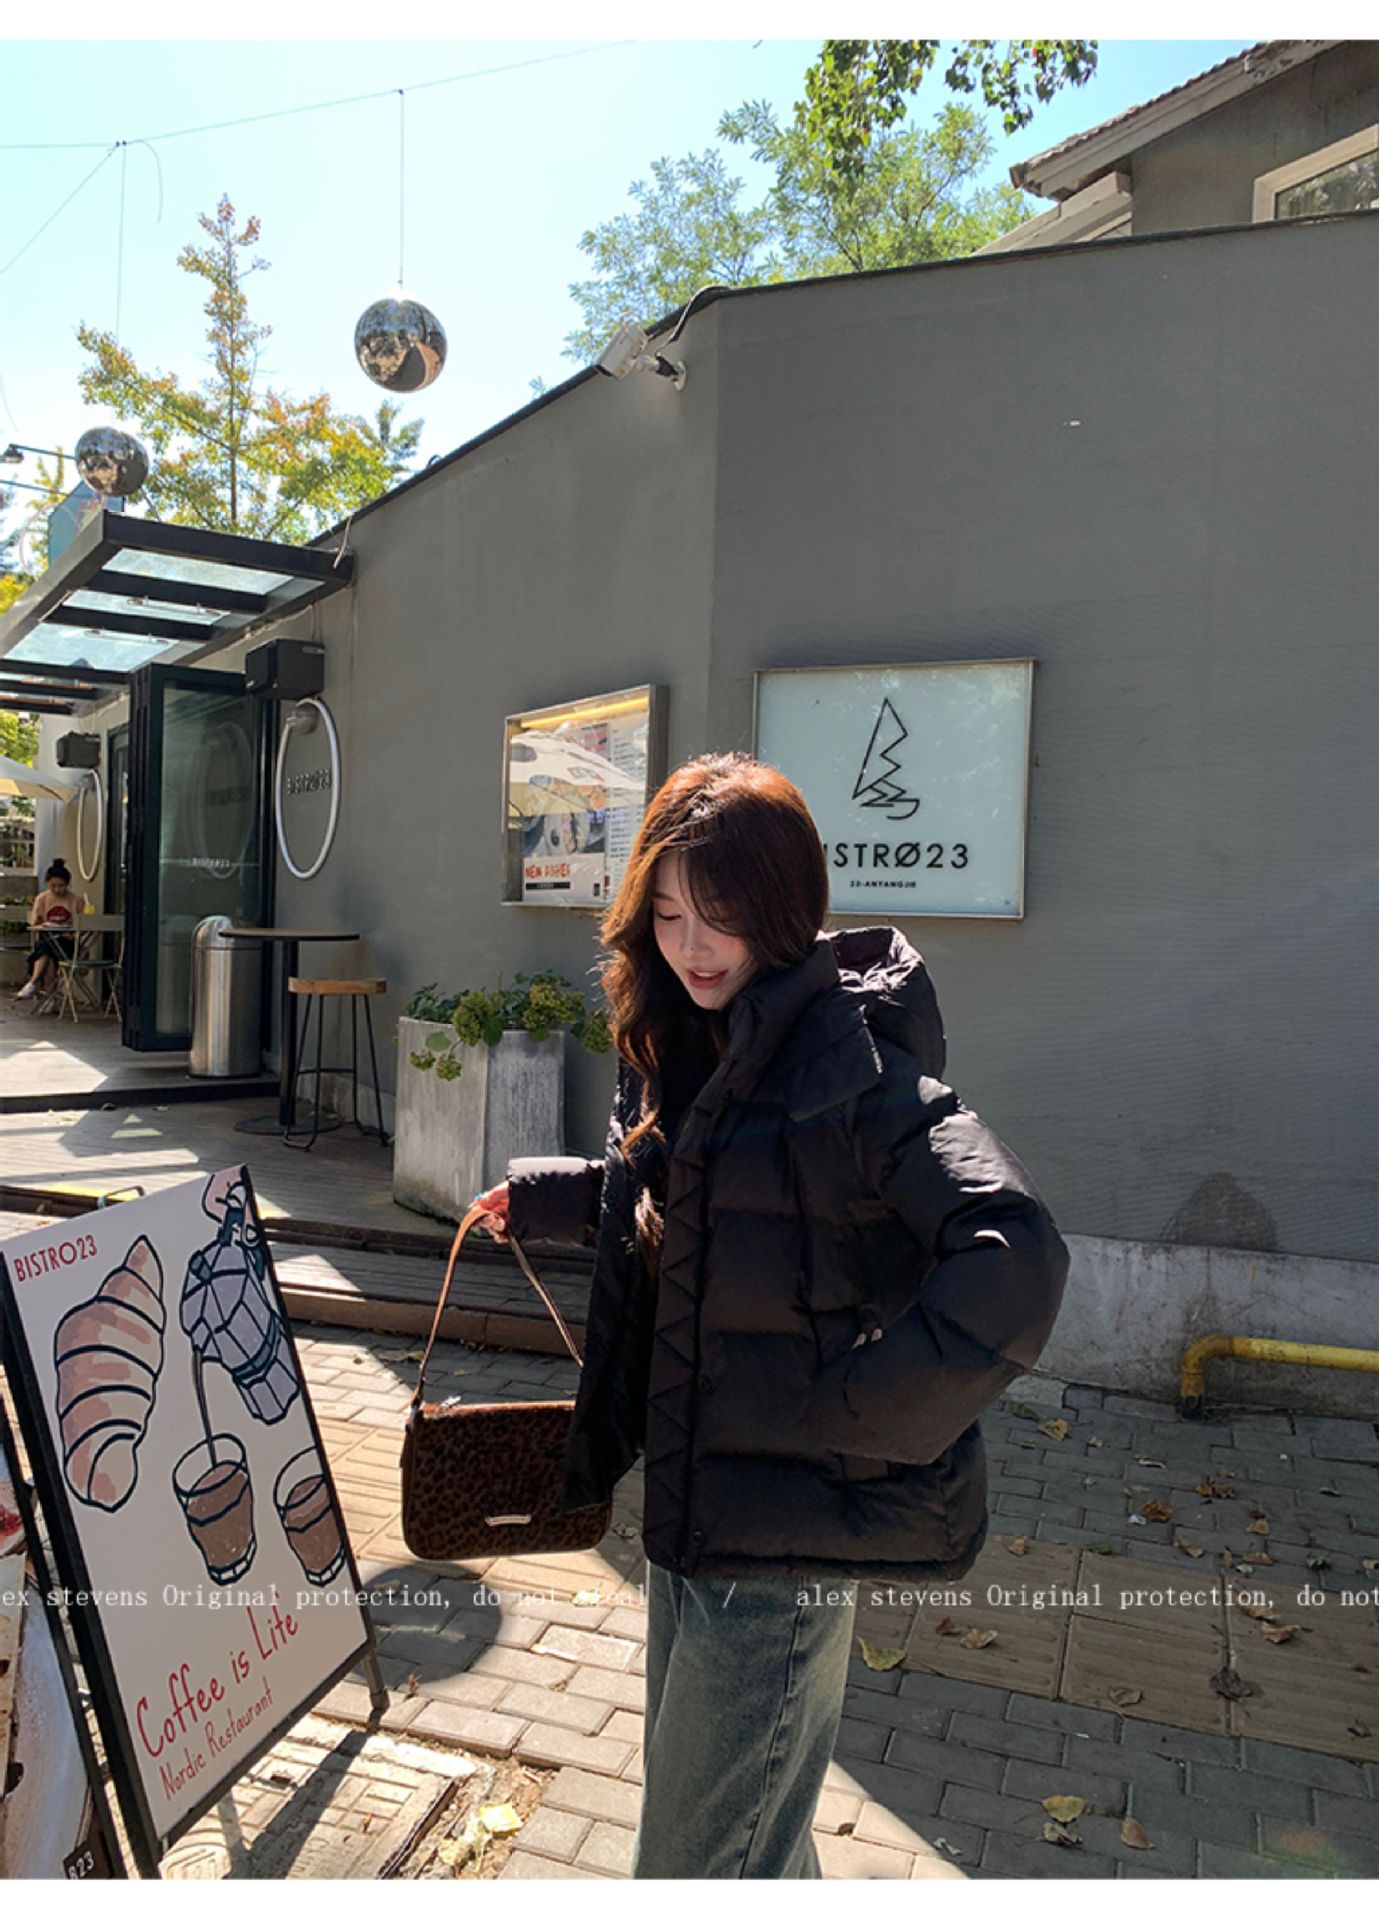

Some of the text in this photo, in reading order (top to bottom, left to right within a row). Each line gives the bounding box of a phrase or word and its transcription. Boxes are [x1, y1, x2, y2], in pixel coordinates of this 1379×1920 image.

[823, 842, 968, 869] STRØ23
[14, 1234, 97, 1282] BISTRO23
[136, 1663, 225, 1757] Coffee
[229, 1651, 250, 1684] is
[159, 1675, 274, 1800] Nordic Restaurant
